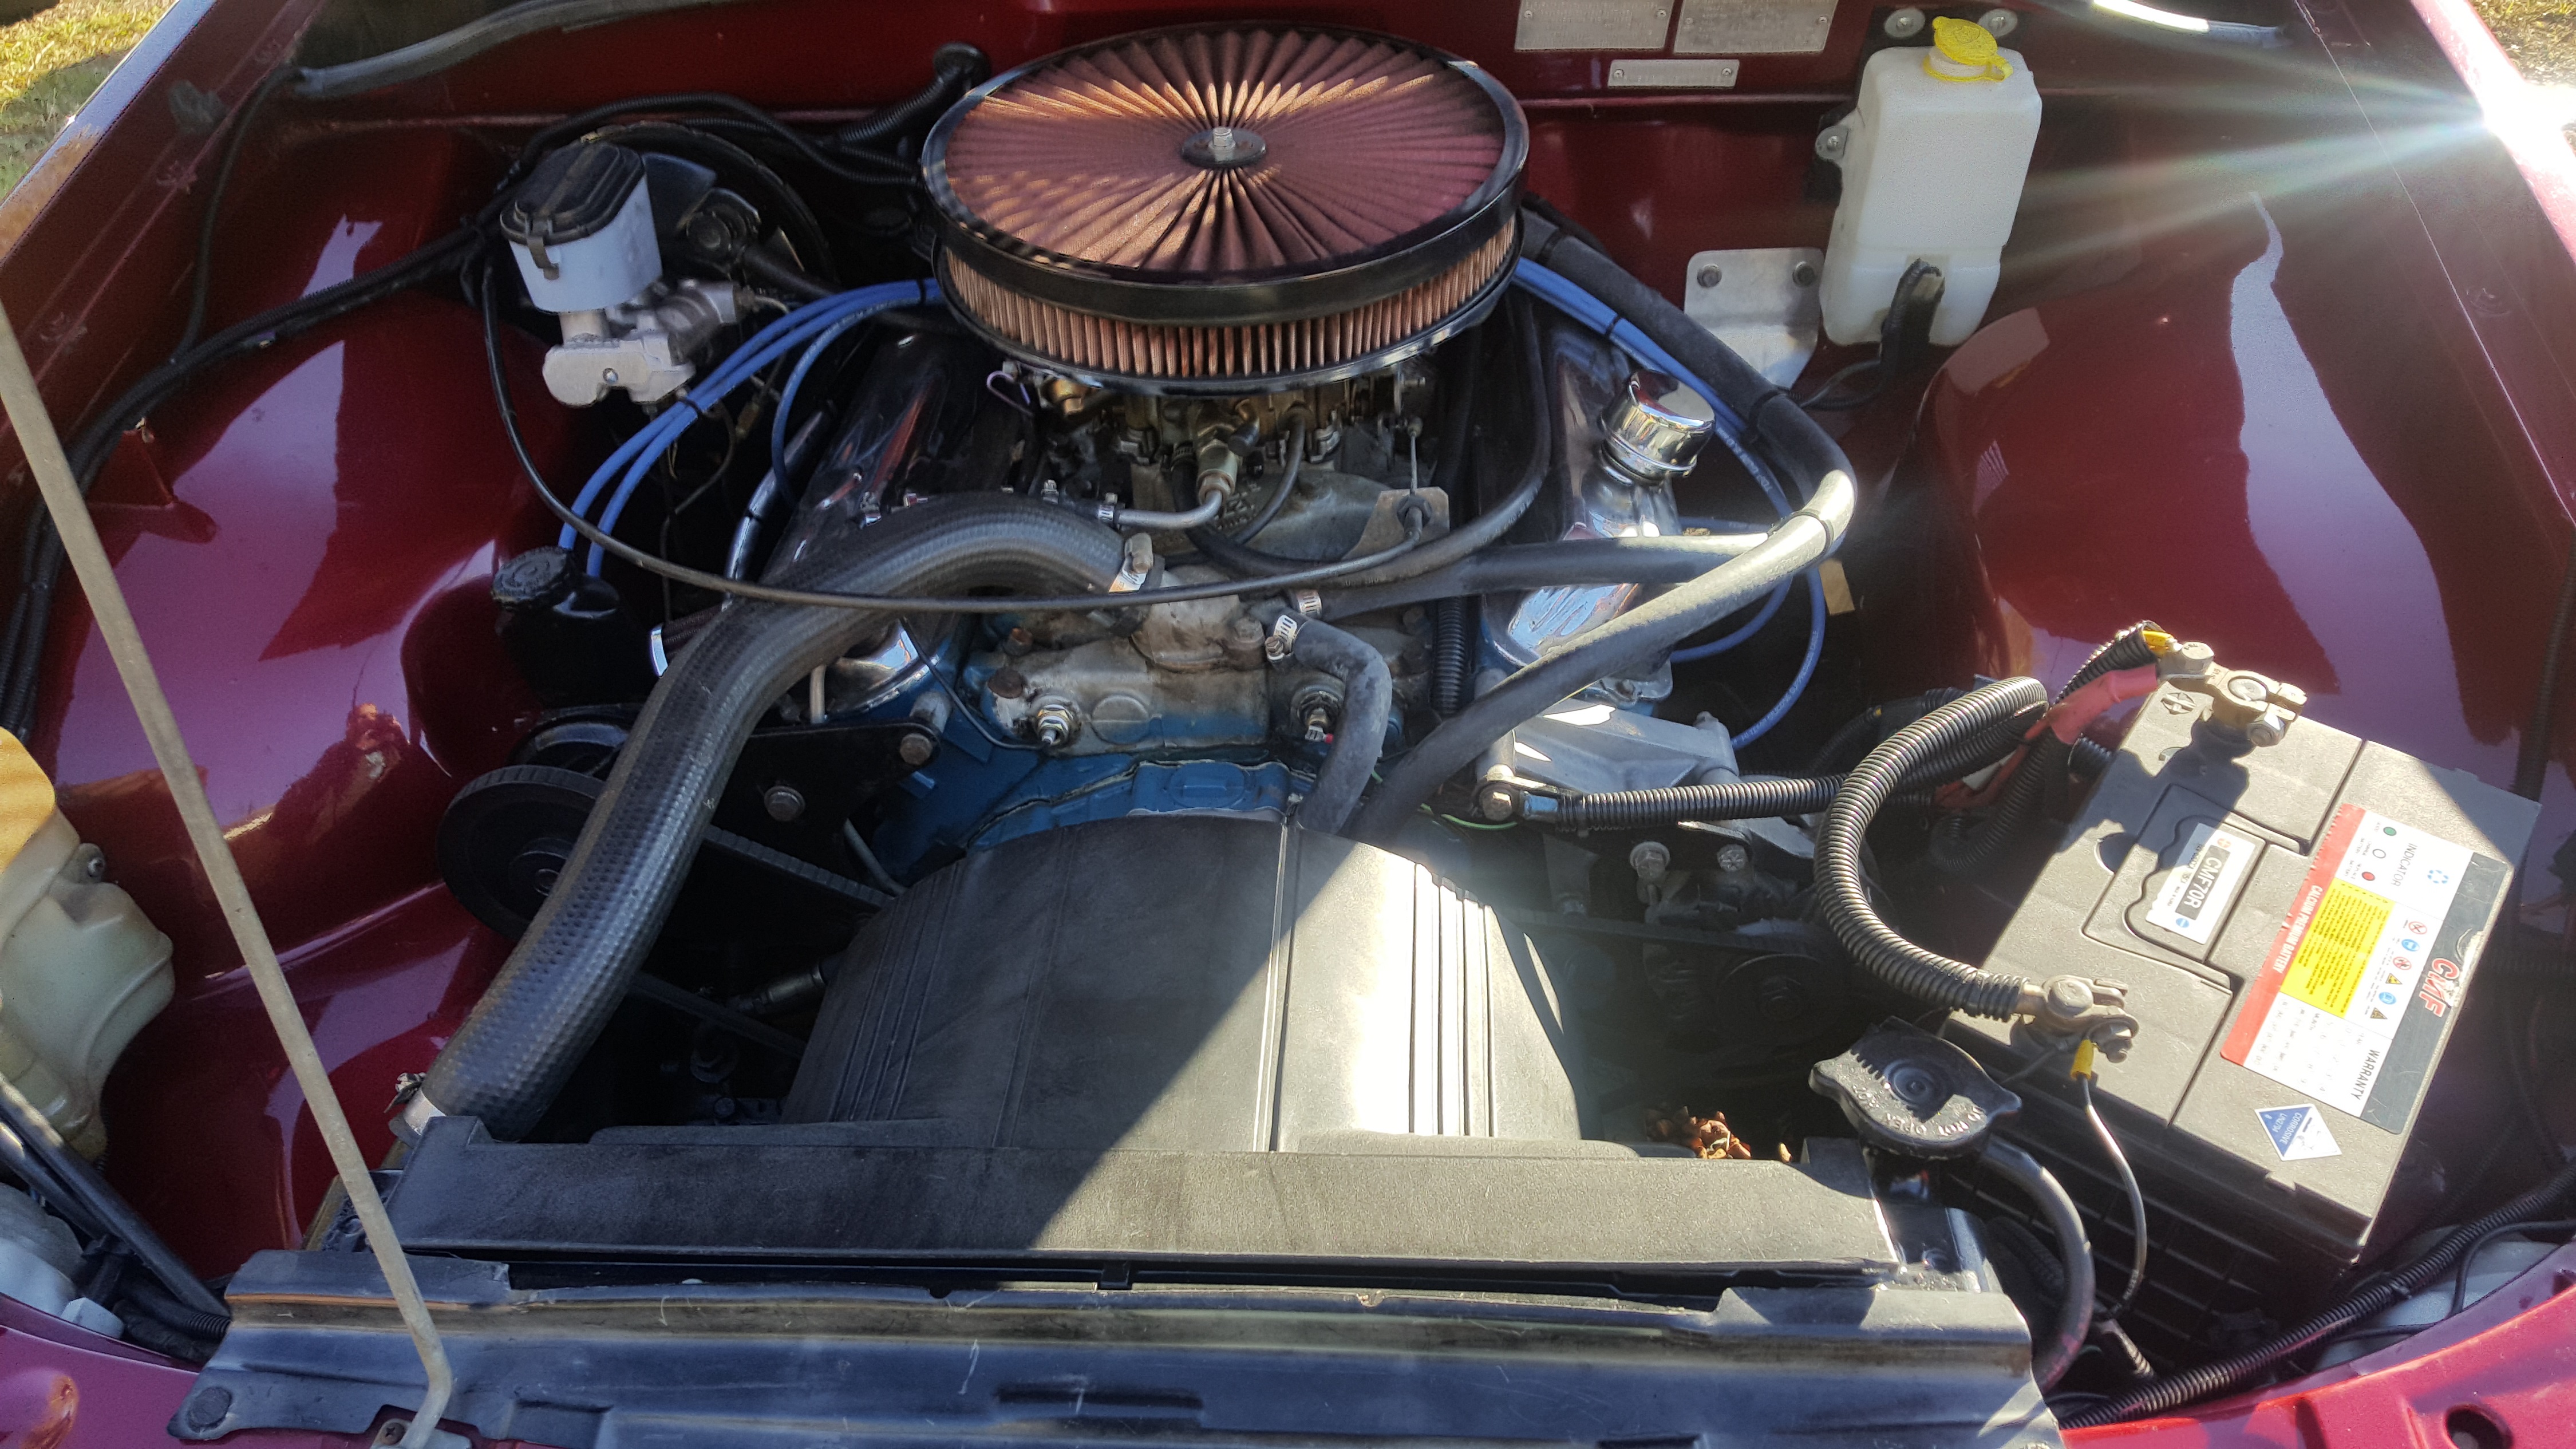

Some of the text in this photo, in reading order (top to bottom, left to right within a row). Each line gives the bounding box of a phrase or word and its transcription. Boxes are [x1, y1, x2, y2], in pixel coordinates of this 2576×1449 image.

[2183, 855, 2223, 909] CMF70R
[2390, 843, 2417, 887] INDICATOR
[2300, 885, 2323, 915] CALCIUM
[2286, 913, 2309, 945] PREMIUM
[2272, 943, 2294, 973] BATTERY
[2418, 958, 2460, 1017] CMF
[2350, 1049, 2380, 1100] WARRANTY
[2279, 1112, 2302, 1144] CORROSIVE
